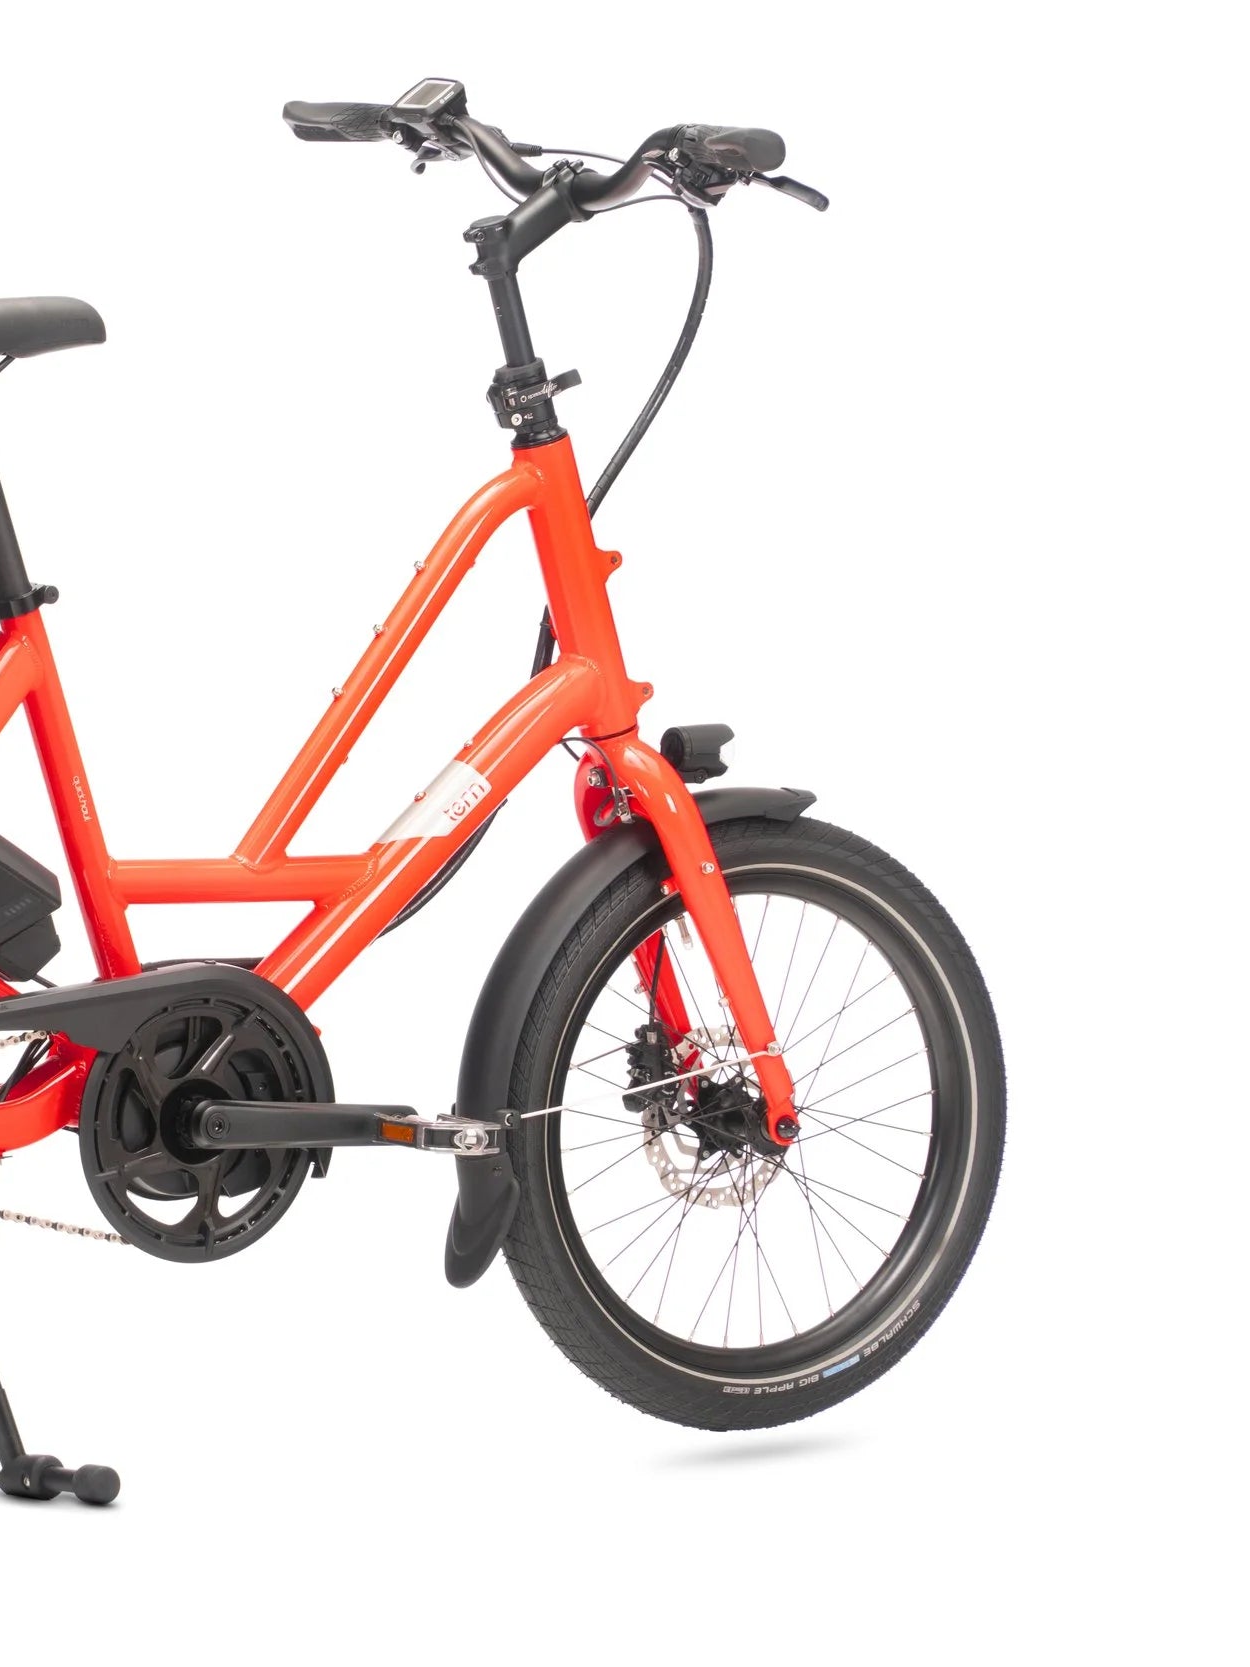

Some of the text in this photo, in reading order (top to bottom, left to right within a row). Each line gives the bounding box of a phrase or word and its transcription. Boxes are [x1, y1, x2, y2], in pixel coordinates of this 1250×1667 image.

[863, 1299, 921, 1358] SCHWALBE
[753, 1381, 795, 1395] APPLE
[798, 1373, 820, 1388] BIG
